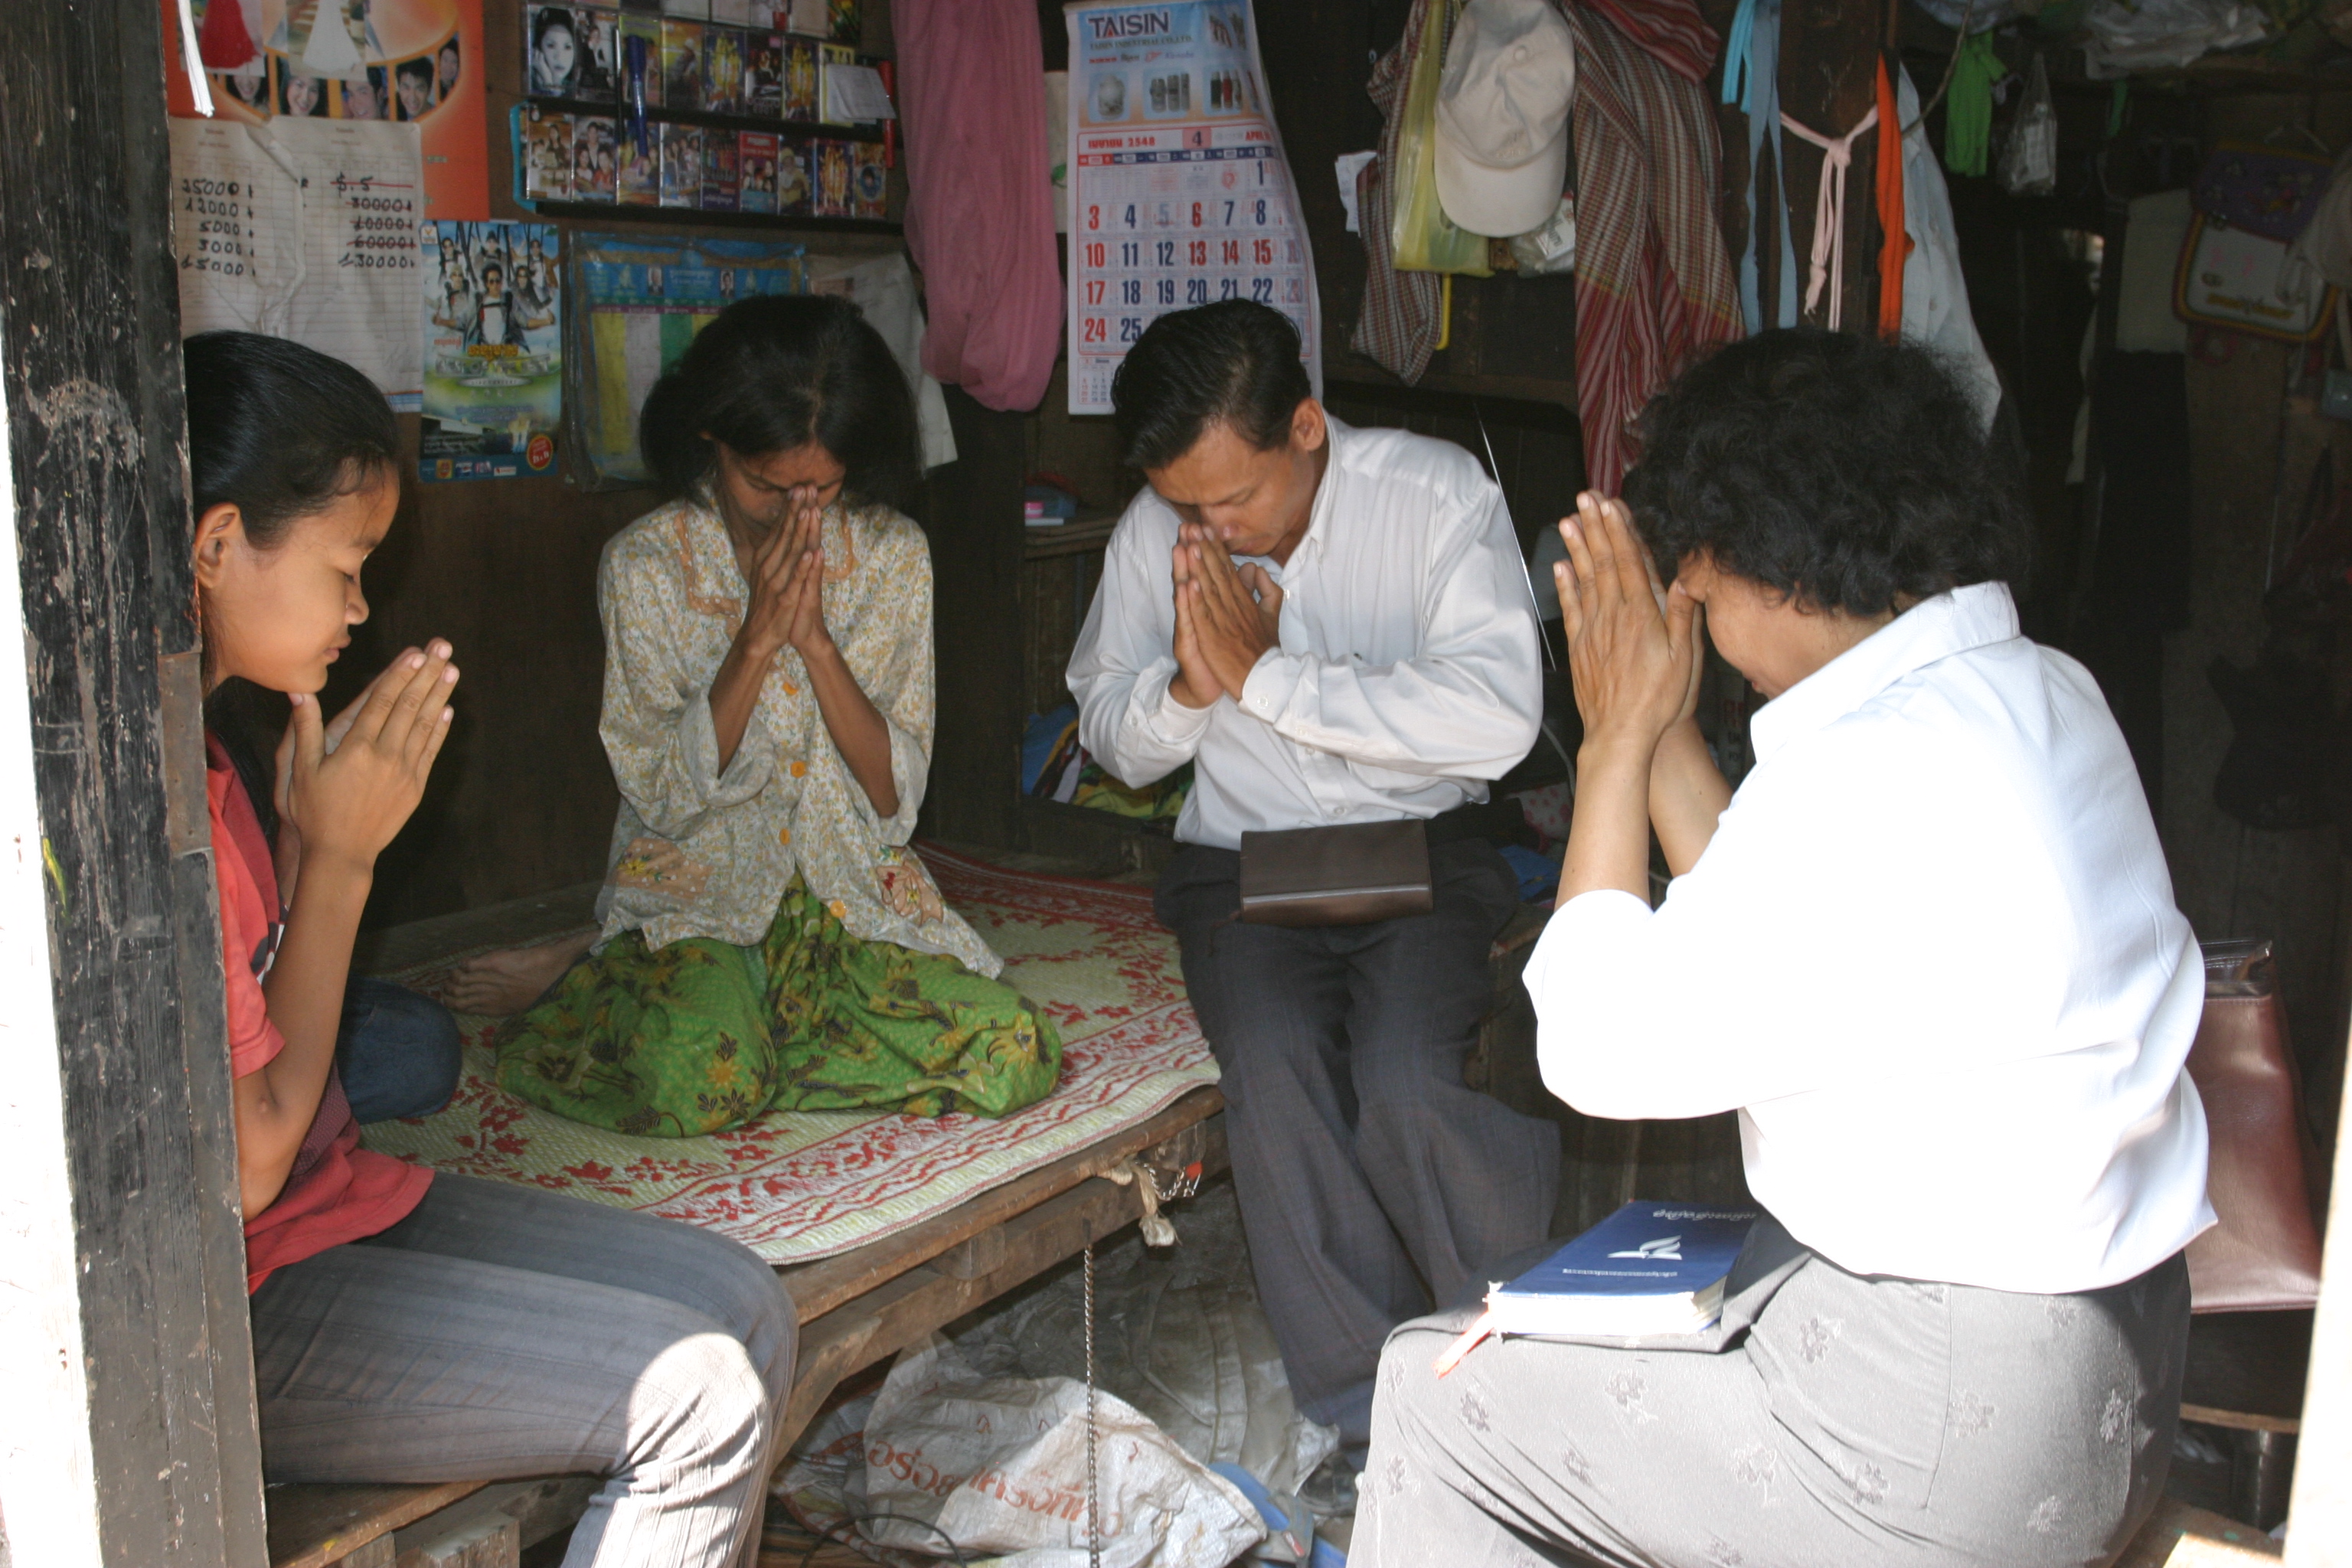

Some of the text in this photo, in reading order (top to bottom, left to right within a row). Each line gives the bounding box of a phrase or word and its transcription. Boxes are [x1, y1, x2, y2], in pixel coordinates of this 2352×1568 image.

[1088, 11, 1169, 38] TAISIN
[1128, 136, 1155, 148] 2548
[1192, 131, 1203, 146] 4
[1257, 159, 1263, 186] 1
[1089, 204, 1099, 230] 3
[1125, 204, 1136, 229] 4
[1159, 202, 1169, 228] 5
[1191, 201, 1202, 227] 6
[1225, 201, 1234, 227] 7
[1256, 199, 1266, 226] 8
[1086, 243, 1105, 268] 10
[1122, 242, 1138, 267] 11
[1156, 241, 1174, 266] 12
[1188, 240, 1207, 266] 13
[1222, 240, 1239, 265] 14
[1253, 239, 1272, 264] 15
[1086, 280, 1106, 305] 17
[1122, 279, 1141, 305] 18
[1156, 279, 1174, 305] 19
[1187, 279, 1207, 305] 20
[1221, 278, 1237, 300] 21
[1253, 278, 1273, 303] 22
[1084, 317, 1142, 343] 24 25
